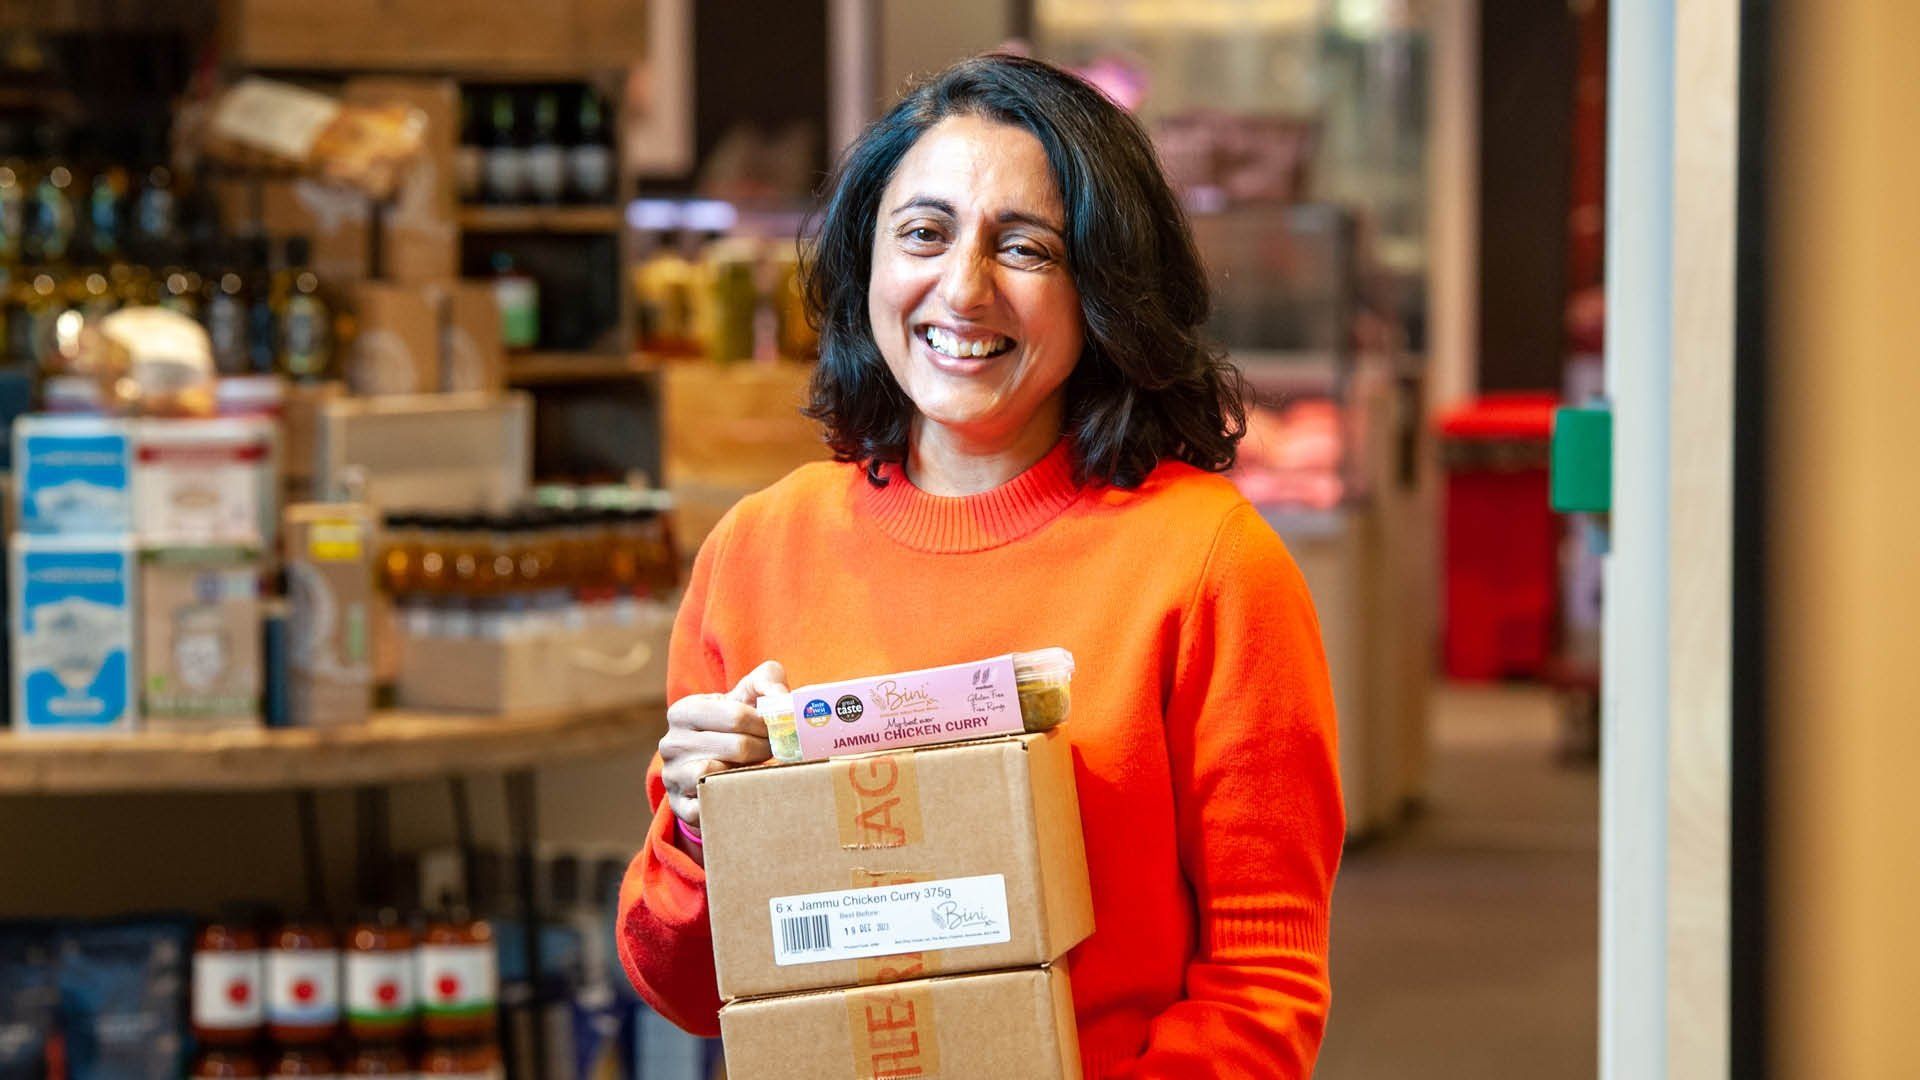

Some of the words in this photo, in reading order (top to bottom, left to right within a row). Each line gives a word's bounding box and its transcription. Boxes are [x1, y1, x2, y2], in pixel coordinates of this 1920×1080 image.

[837, 704, 862, 715] taste
[876, 680, 929, 711] Bini
[833, 733, 880, 749] JAMMU
[884, 723, 942, 741] CHICKEN
[946, 716, 989, 732] CURRY
[776, 903, 783, 914] 6
[787, 904, 793, 912] x
[800, 899, 840, 912] Jammu
[843, 894, 887, 906] Chicken
[890, 890, 920, 902] Curry
[924, 887, 951, 899] 375g
[936, 900, 987, 930] Bini
